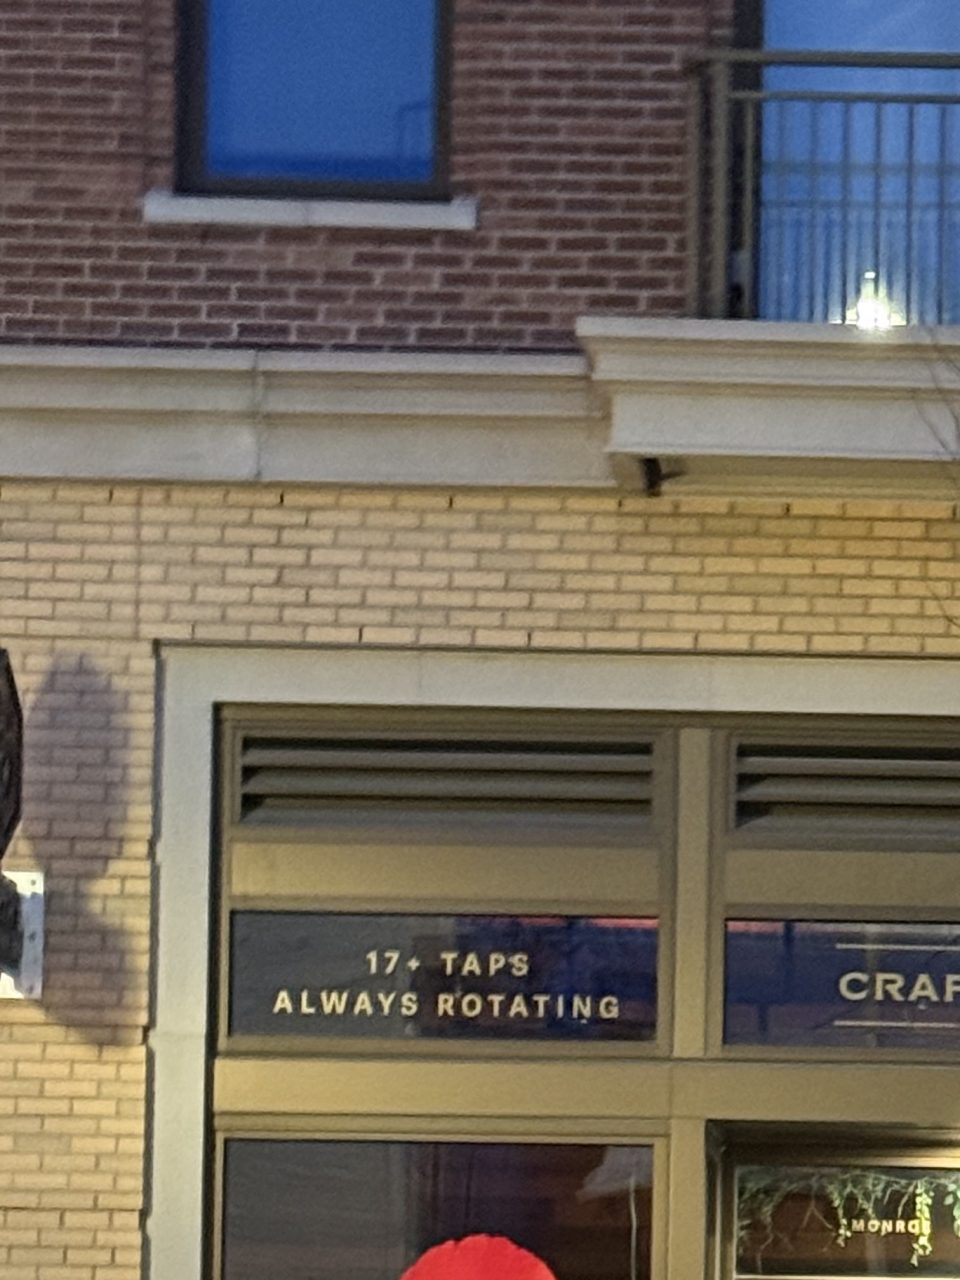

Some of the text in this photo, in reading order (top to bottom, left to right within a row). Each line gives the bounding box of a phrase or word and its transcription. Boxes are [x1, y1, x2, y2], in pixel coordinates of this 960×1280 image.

[365, 949, 530, 977] 17+ TAPS
[273, 989, 620, 1020] ALWAYS ROTATING
[851, 1218, 931, 1234] MONRO
